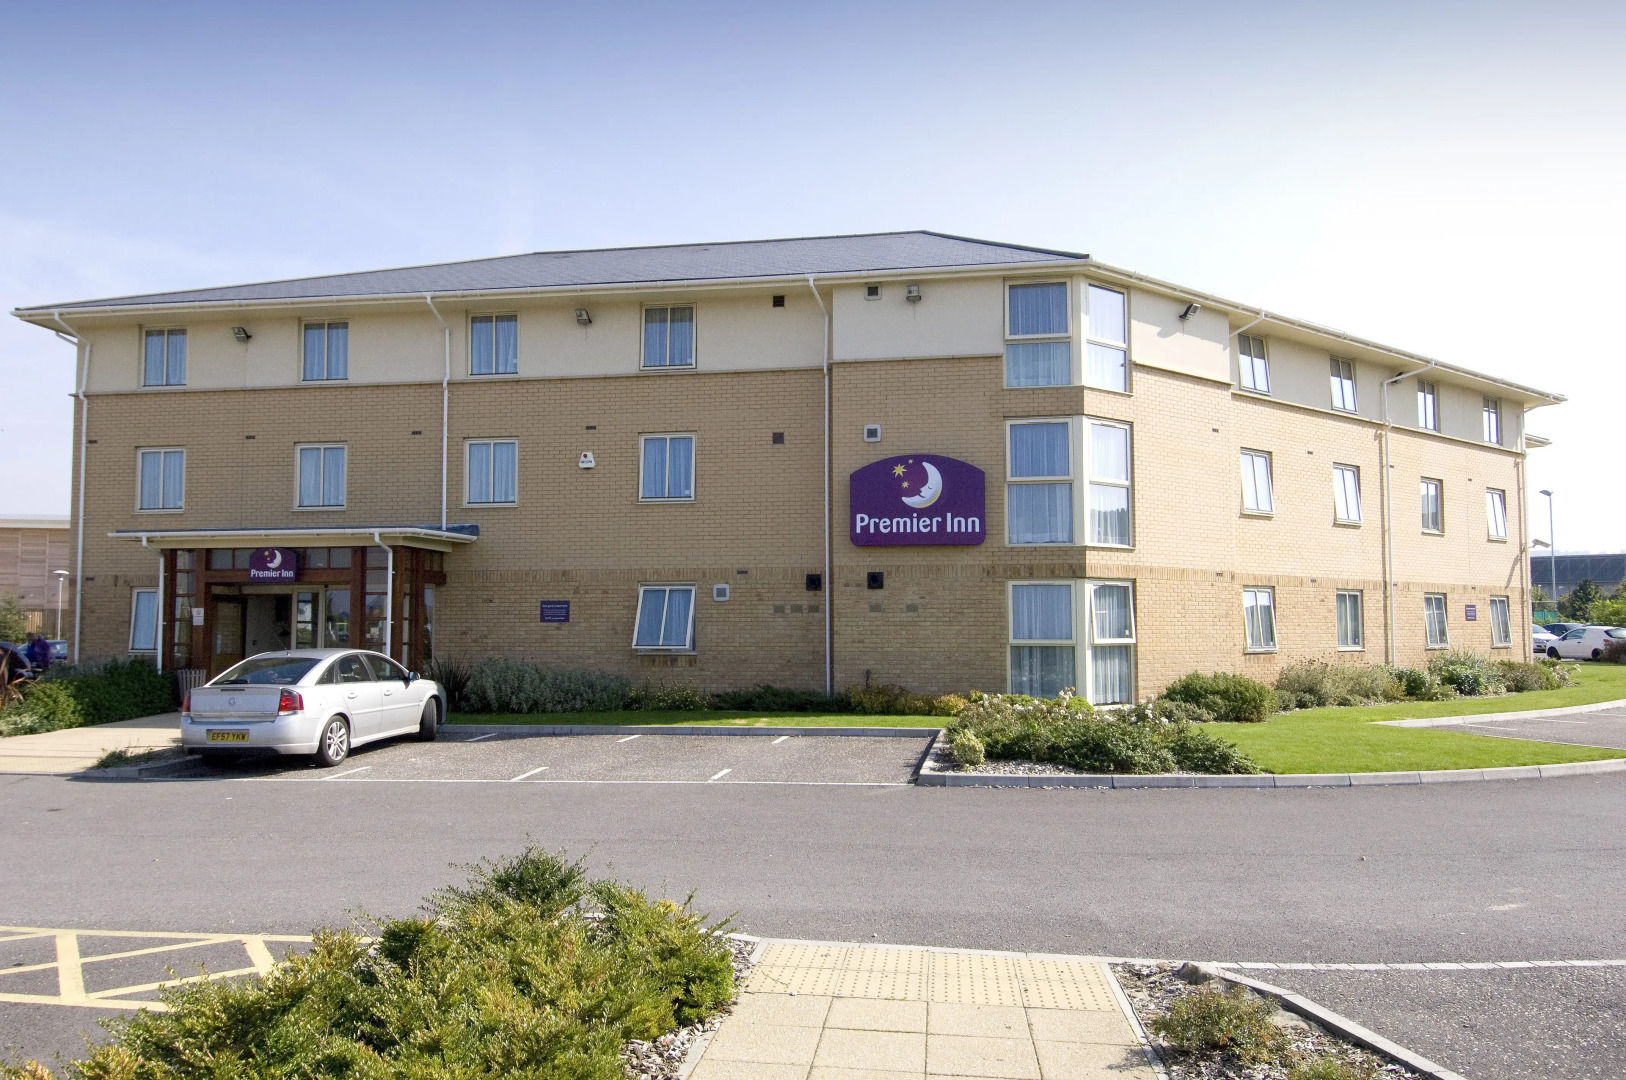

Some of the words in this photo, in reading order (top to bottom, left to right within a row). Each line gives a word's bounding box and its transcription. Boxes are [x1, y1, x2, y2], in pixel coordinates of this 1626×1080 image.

[856, 513, 942, 534] Premier
[946, 512, 980, 533] Inn
[250, 568, 281, 578] Premier
[281, 568, 294, 577] Inn
[211, 732, 231, 741] EF57
